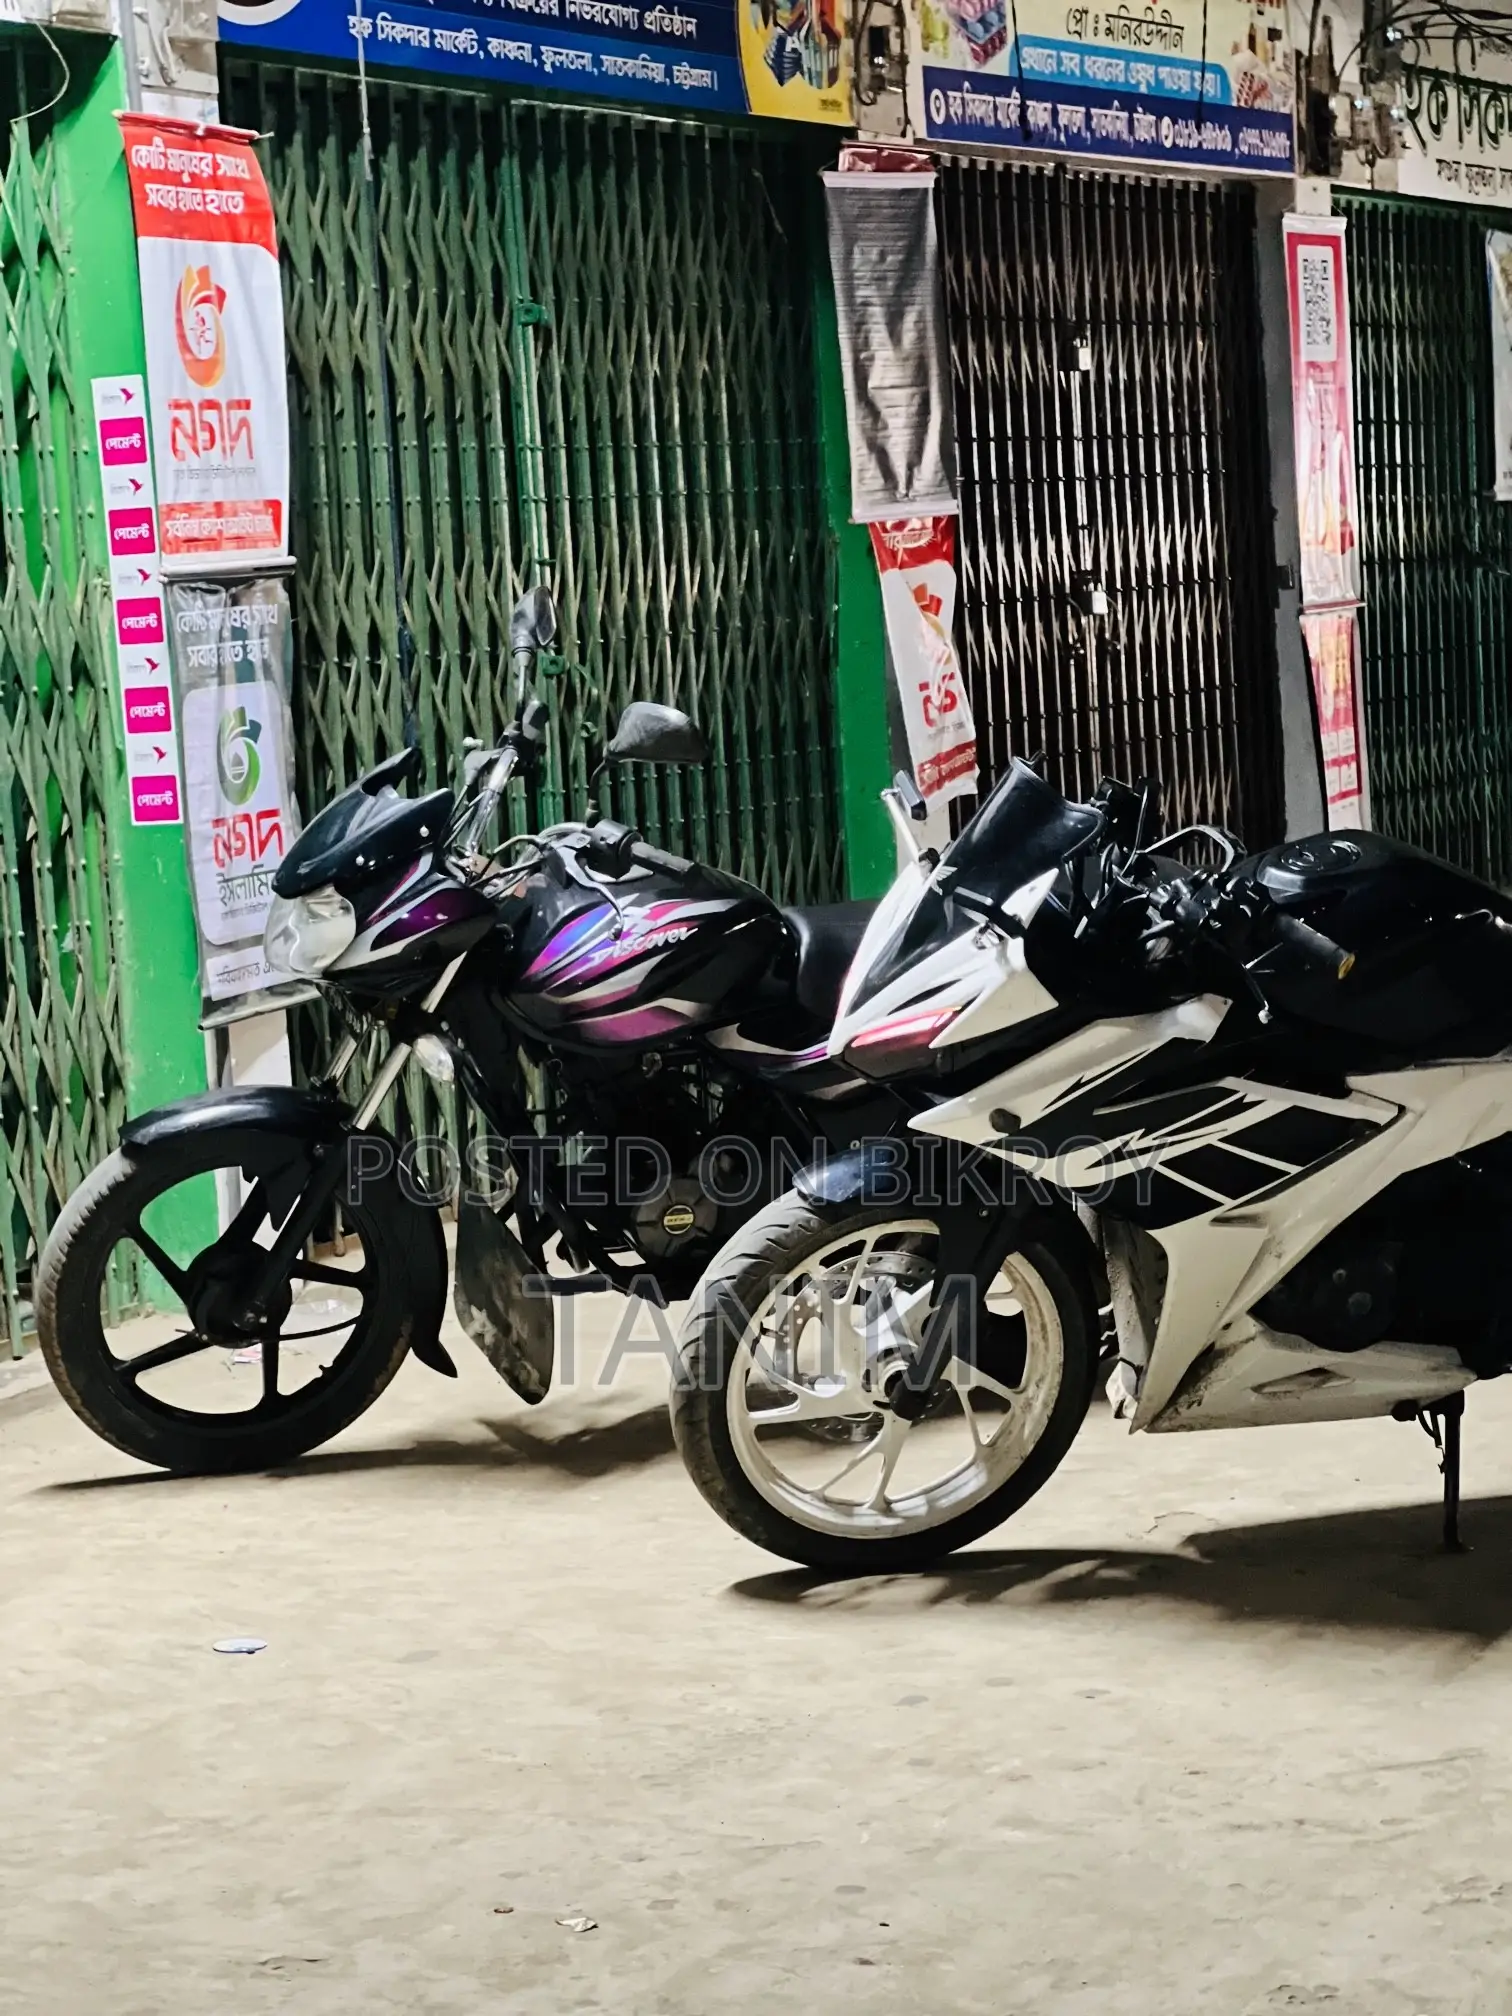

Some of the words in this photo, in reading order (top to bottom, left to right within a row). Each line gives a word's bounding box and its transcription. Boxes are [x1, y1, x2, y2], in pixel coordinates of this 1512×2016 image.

[376, 12, 430, 48] সিকদার
[643, 5, 698, 39] প্রতিষ্ঠান
[1060, 50, 1081, 77] সব
[131, 136, 165, 169] কোটি
[203, 189, 245, 215] হাতে
[105, 433, 141, 450] পেমেন্ট
[168, 398, 254, 462] নগদ
[114, 524, 149, 540] পেমেন্ট
[122, 614, 157, 629] পেমেন্ট
[130, 702, 165, 718] পেমেন্ট
[137, 791, 173, 807] পেমেন্ট
[211, 808, 284, 869] নগদ
[216, 864, 278, 906] ইসলামি
